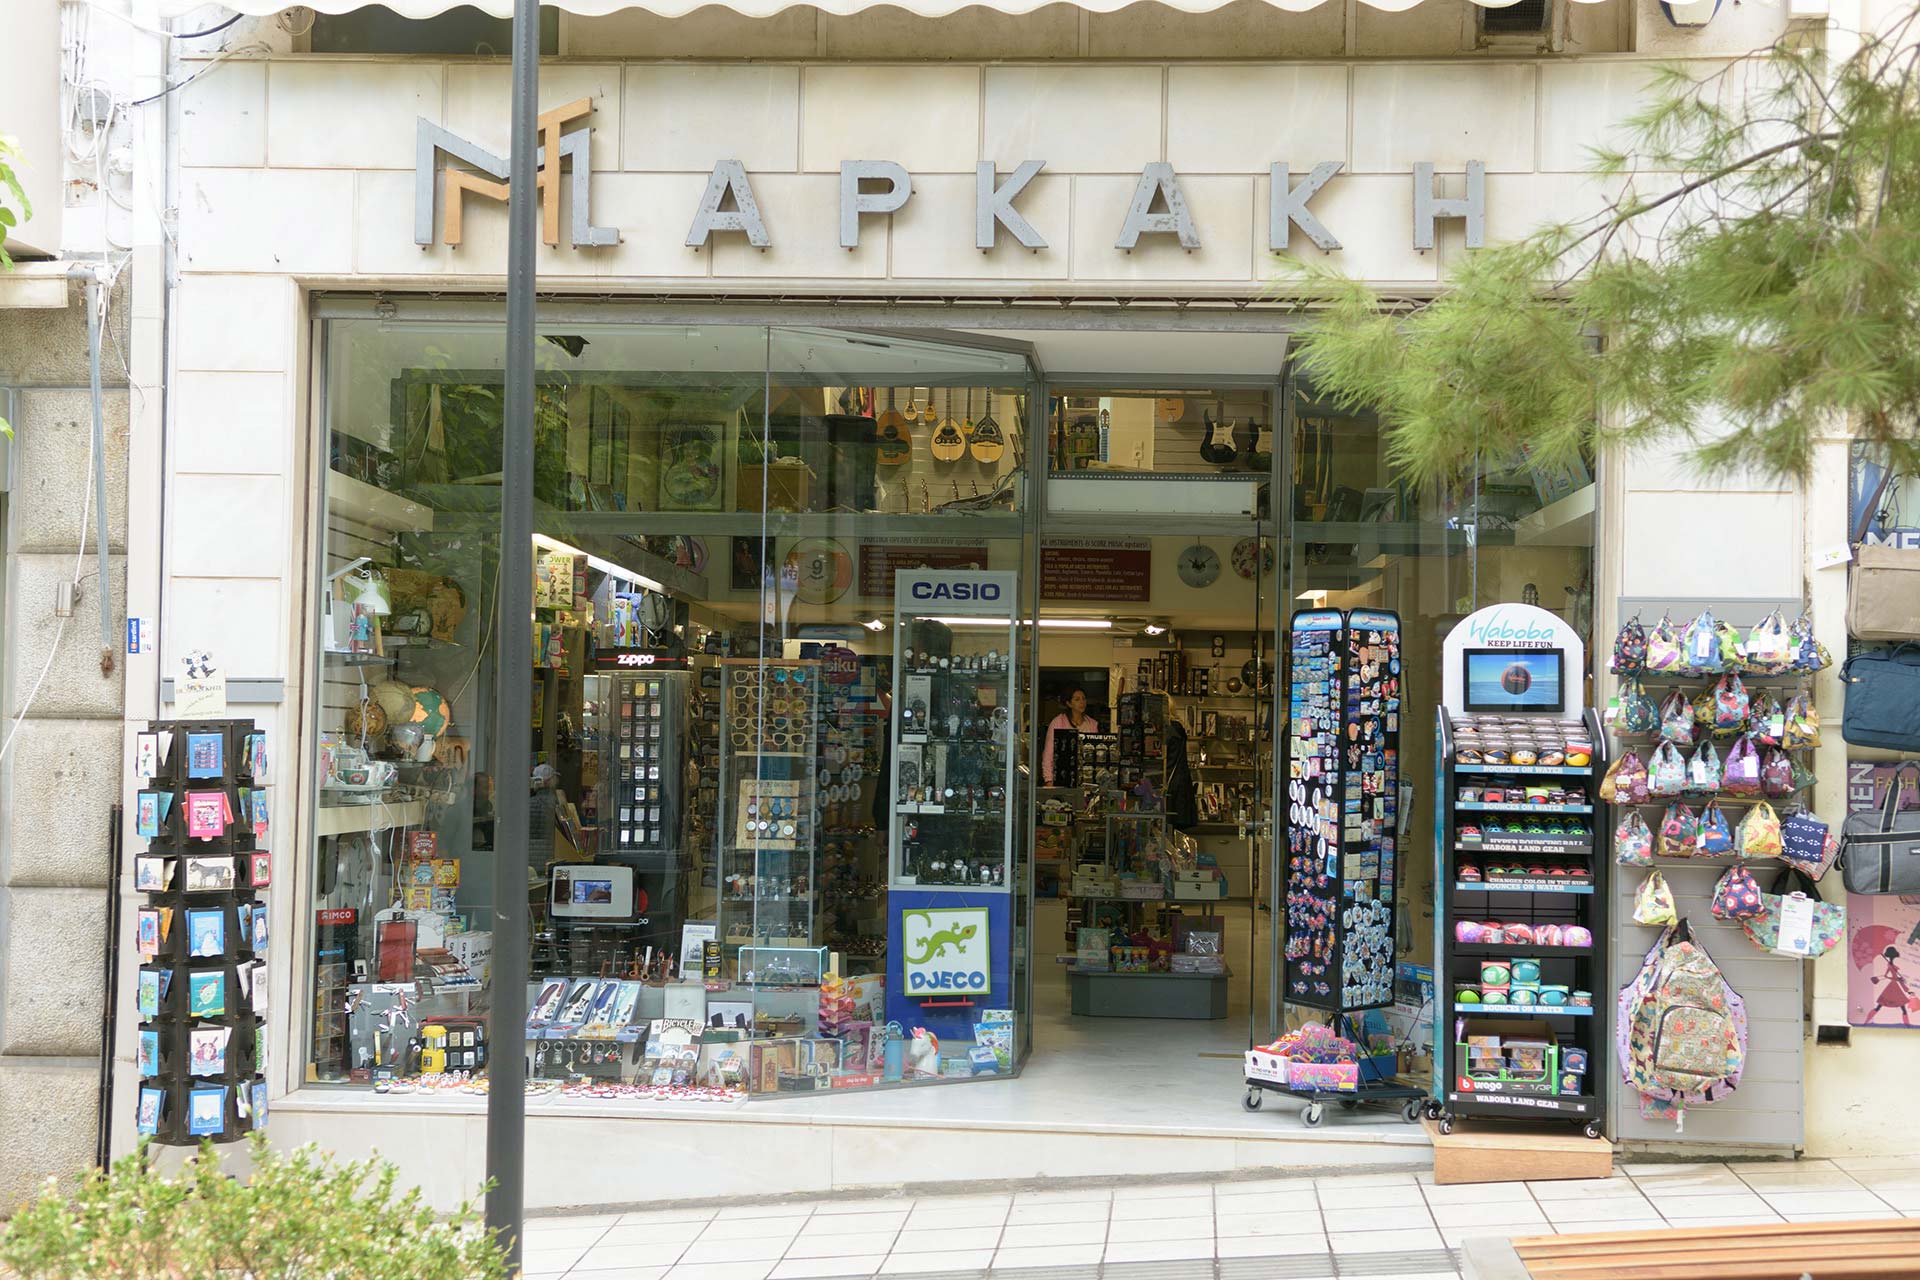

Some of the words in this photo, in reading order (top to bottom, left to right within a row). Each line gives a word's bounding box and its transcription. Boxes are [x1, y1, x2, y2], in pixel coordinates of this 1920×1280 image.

[912, 581, 1001, 601] CASIO
[1470, 608, 1554, 643] Waboba
[1487, 639, 1512, 648] KEEP
[1513, 640, 1533, 648] LIFE
[1535, 640, 1553, 649] FUN
[617, 654, 655, 667] zippo
[1483, 765, 1520, 773] BOUNCES
[1521, 766, 1533, 774] ON
[1535, 766, 1563, 774] WATER
[1483, 802, 1520, 810] BOUNCES
[1521, 803, 1533, 811] ON
[1535, 803, 1563, 812] WATER
[1482, 843, 1517, 852] WABOBA
[1518, 844, 1541, 853] LAND
[1542, 845, 1565, 853] GEAR
[328, 911, 352, 920] IMCO
[909, 971, 986, 990] DJECO
[1476, 1094, 1512, 1104] WABOBA
[1512, 1096, 1536, 1106] LAND
[1536, 1099, 1560, 1109] GEAR
